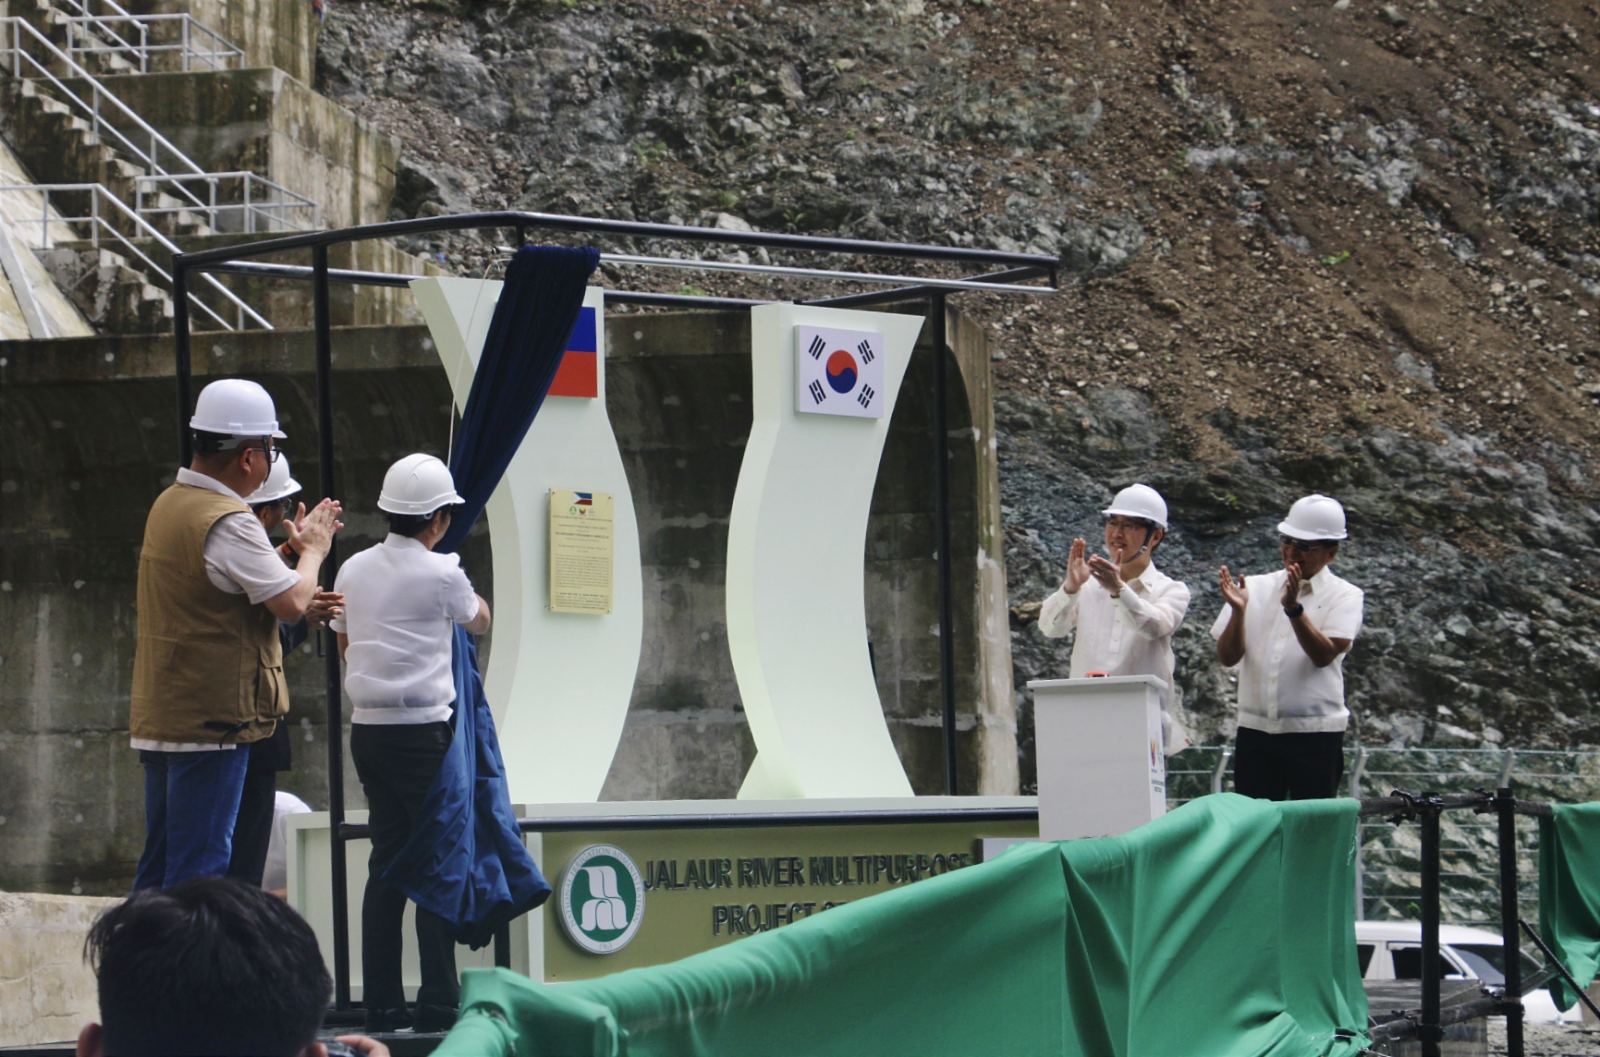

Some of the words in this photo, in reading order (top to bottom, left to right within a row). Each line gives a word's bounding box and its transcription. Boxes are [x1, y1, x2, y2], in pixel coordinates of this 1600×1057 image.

[644, 857, 733, 890] JALAUR
[737, 856, 805, 887] RIVER
[712, 902, 816, 936] PROJECT
